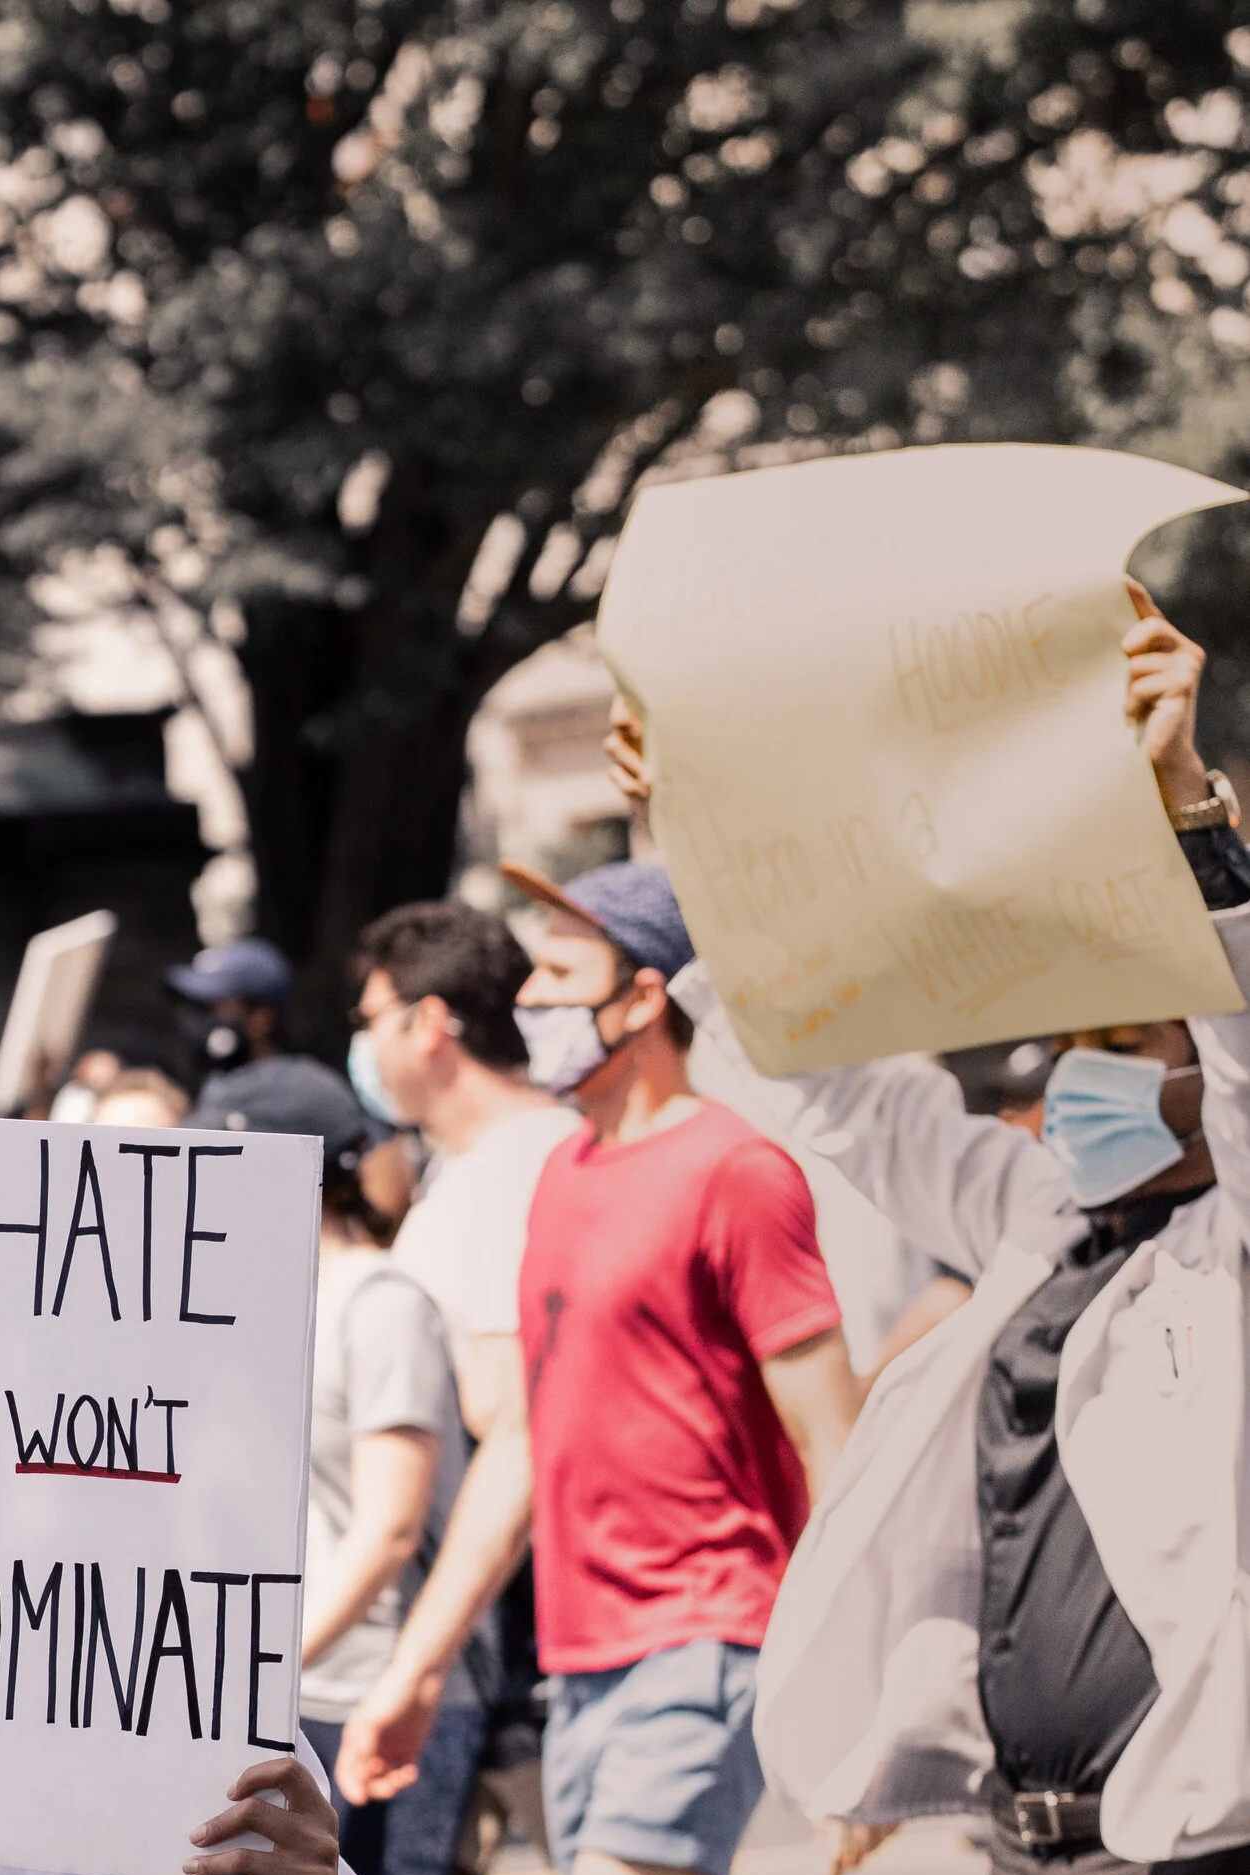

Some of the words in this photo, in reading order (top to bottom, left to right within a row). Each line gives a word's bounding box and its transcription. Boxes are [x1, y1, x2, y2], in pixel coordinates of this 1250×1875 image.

[887, 591, 1071, 728] HOODIE
[876, 893, 1042, 1002] WHITE
[1049, 864, 1157, 946] COAT
[4, 1385, 190, 1476] WON'T
